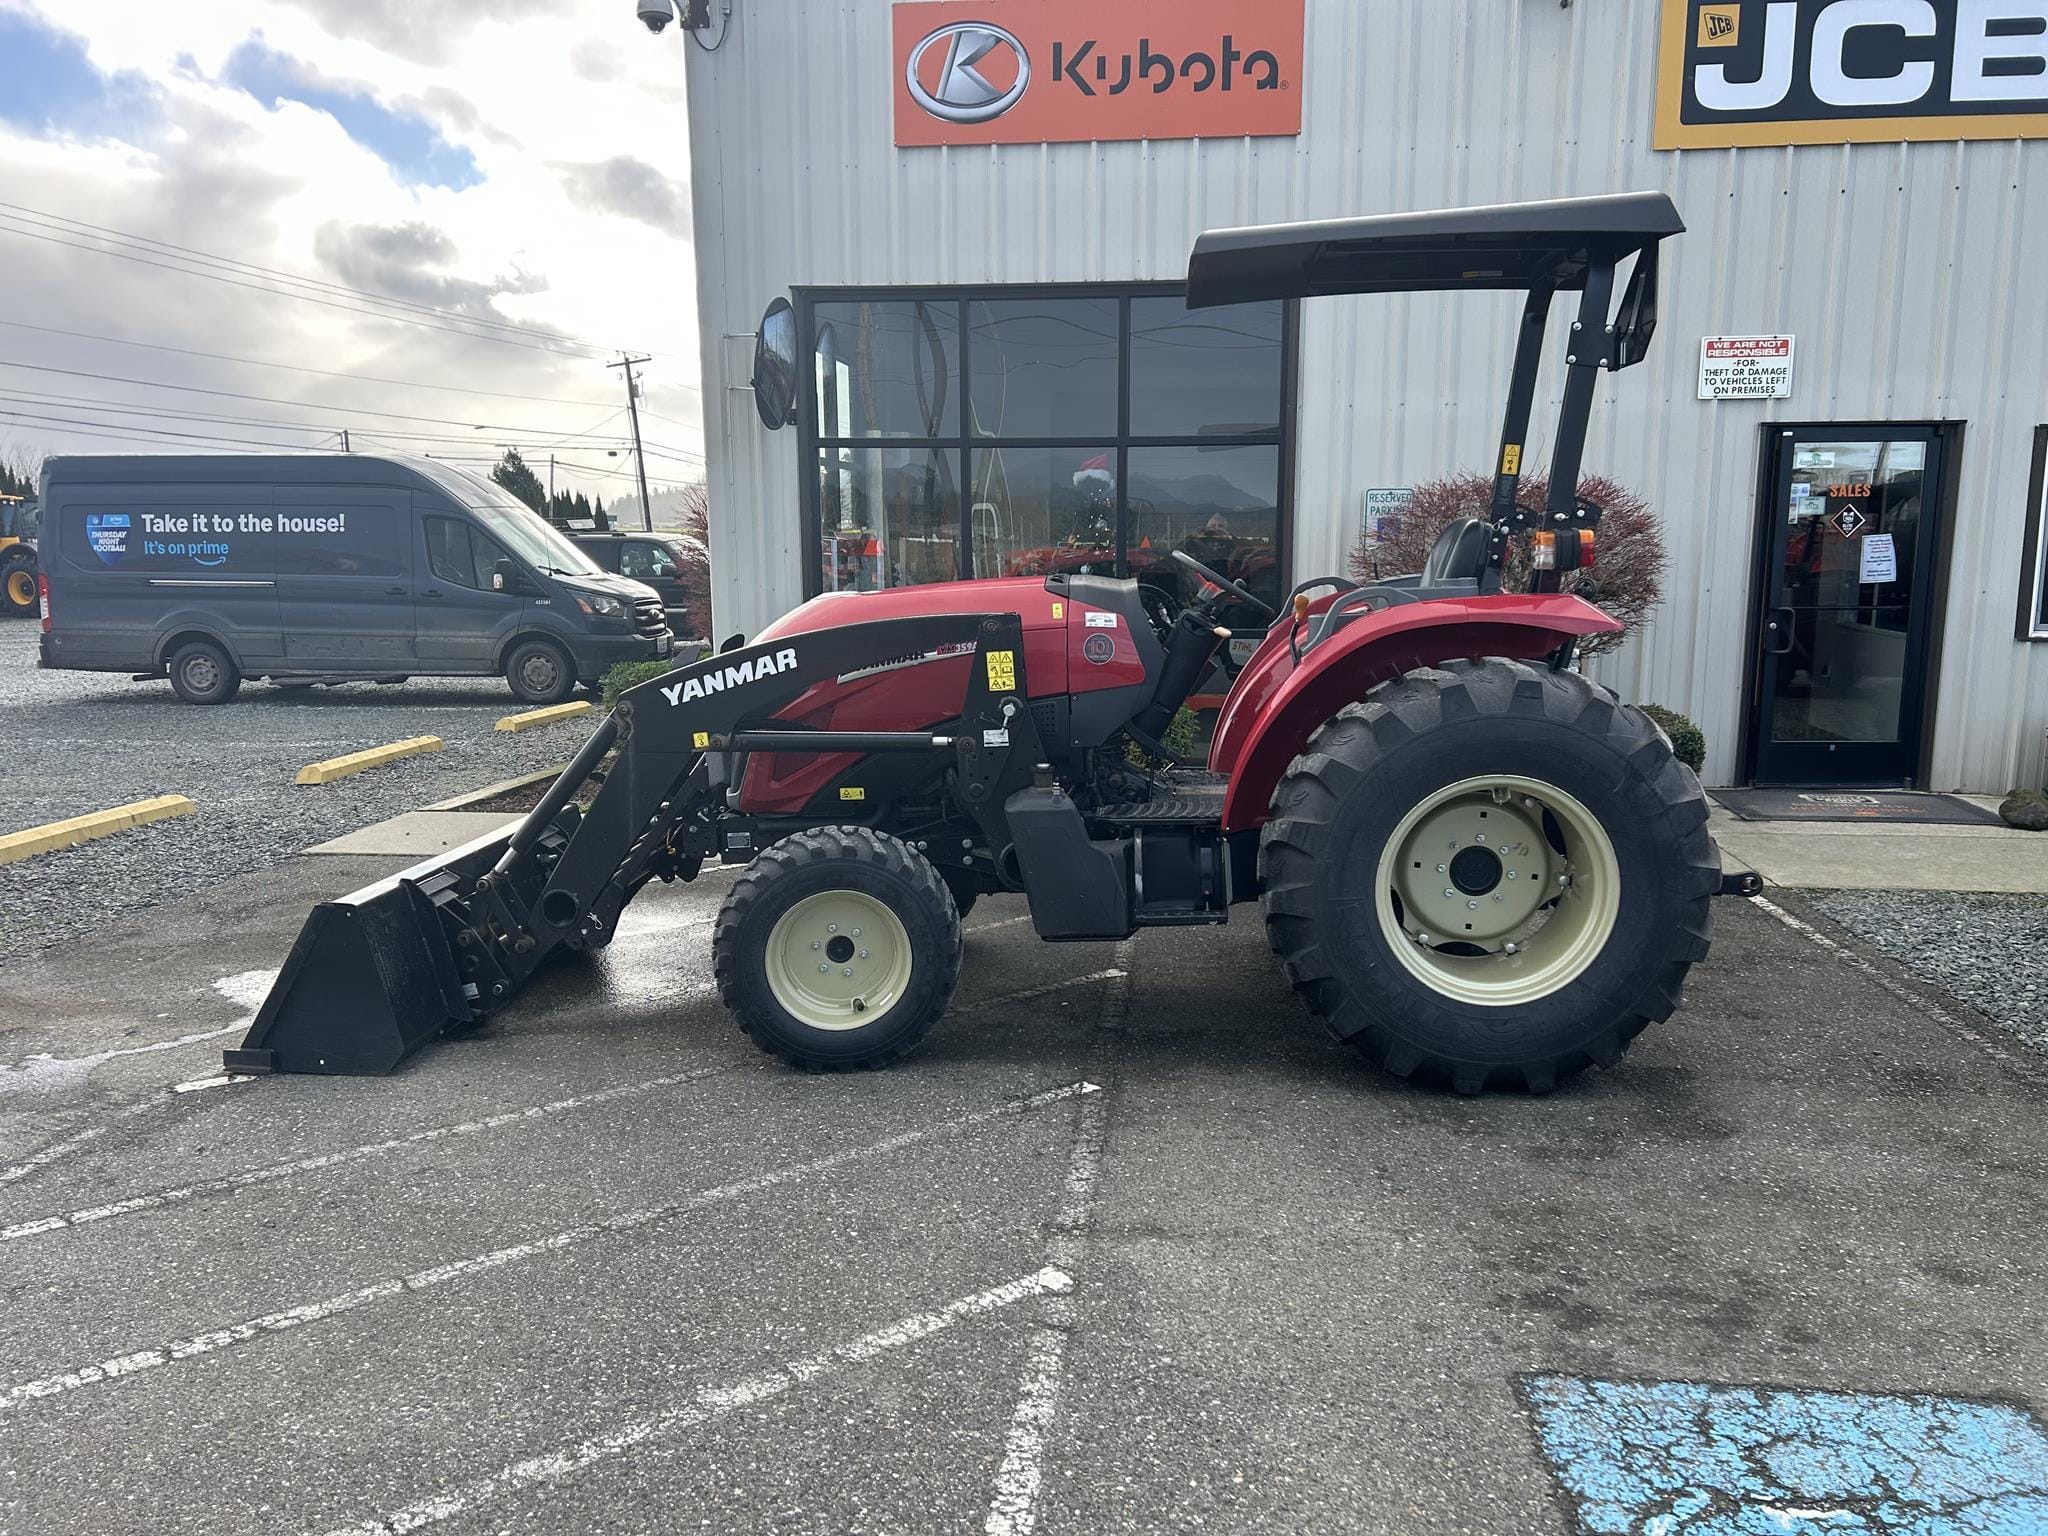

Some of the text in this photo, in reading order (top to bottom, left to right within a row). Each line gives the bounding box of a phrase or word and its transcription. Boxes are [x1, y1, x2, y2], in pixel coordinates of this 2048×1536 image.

[1709, 15, 1733, 37] JCB
[1695, 0, 2048, 110] JCB
[1052, 34, 1279, 96] Kubota
[1707, 348, 1787, 357] RESPONSIBLE
[1731, 368, 1745, 376] OR
[1748, 367, 1788, 376] DAMAGE
[1719, 377, 1763, 385] VEHICLES
[1765, 376, 1787, 385] LEFT
[1731, 386, 1776, 394] PREMISES
[1829, 483, 1872, 497] SALES
[1369, 493, 1411, 503] RESERVED
[1370, 506, 1408, 515] PARKIN
[141, 513, 345, 533] Take it to the house!
[93, 544, 126, 552] FOOTBALL
[144, 540, 229, 557] It's on prime
[1232, 641, 1253, 652] STIHL
[660, 648, 798, 707] YANMAR
